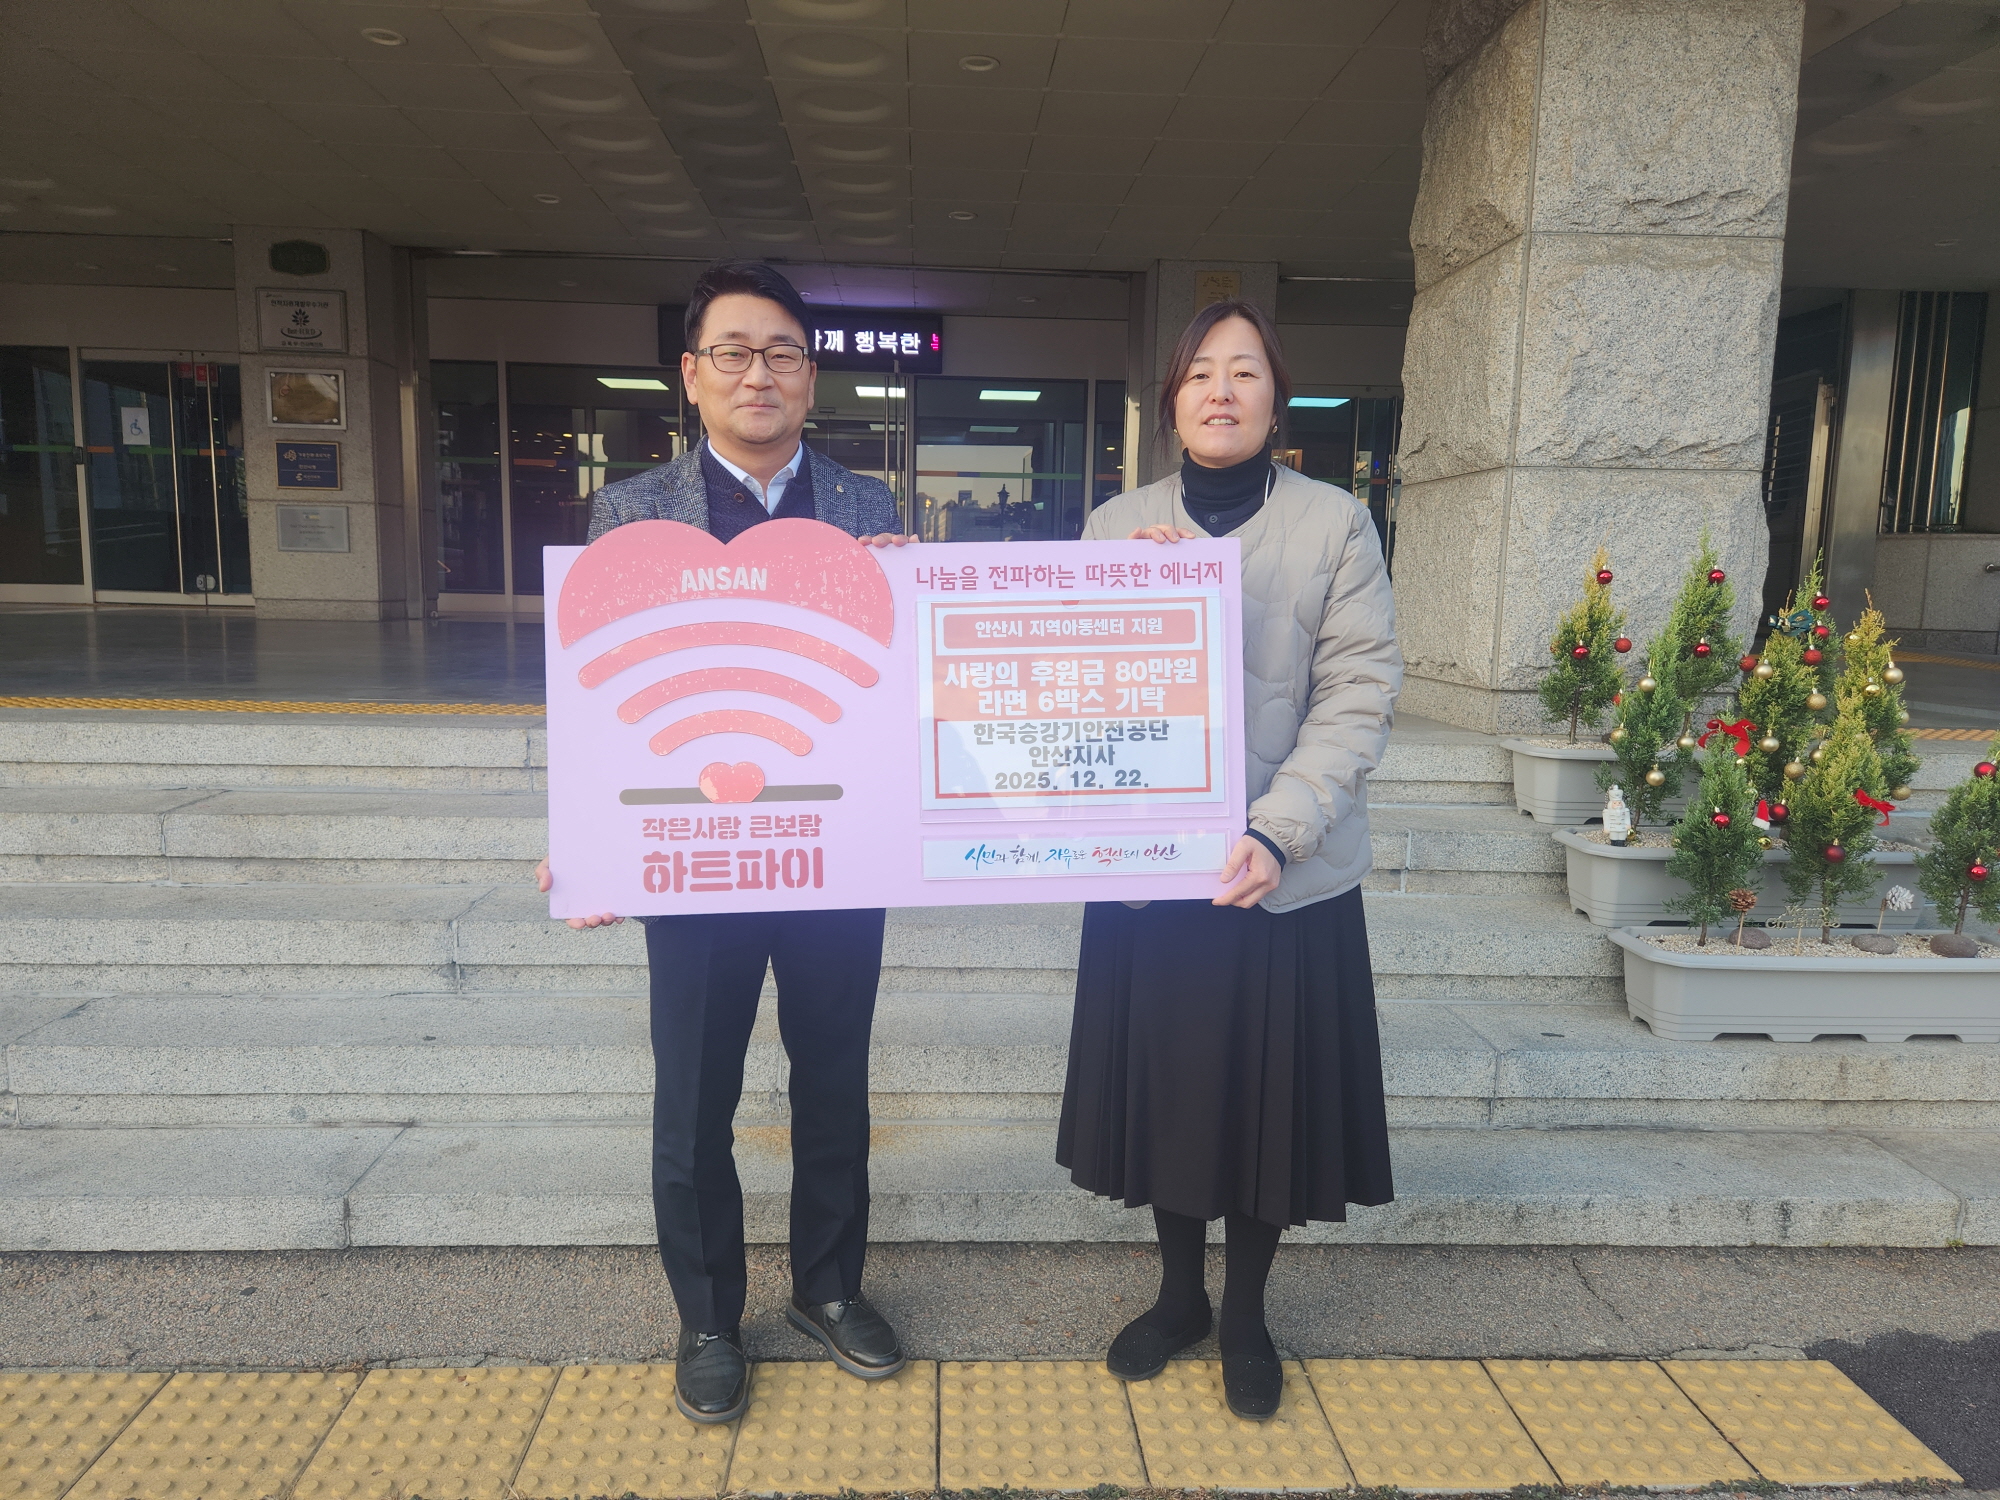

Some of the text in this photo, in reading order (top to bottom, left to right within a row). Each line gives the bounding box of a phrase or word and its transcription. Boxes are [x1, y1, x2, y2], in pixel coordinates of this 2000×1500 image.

[855, 331, 921, 355] 행복한
[681, 566, 768, 593] ANSAN
[916, 561, 1223, 591] 나눔을 전파하는 따뜻한 에너지
[975, 617, 1163, 638] 안산시 지역아동센터 지원
[943, 657, 1198, 689] 사랑의 후원금 80만원
[978, 686, 1166, 716] 라면 6박스 기탁
[973, 719, 1170, 745] 한국승강기안전공단
[1028, 744, 1116, 768] 안산지사
[994, 769, 1149, 791] 2025. 12. 22.
[641, 814, 823, 841] 작은사랑 큰보람
[642, 846, 824, 894] 하트파이
[964, 843, 1009, 870] 시민과
[1044, 848, 1087, 869] 자유로운
[1091, 846, 1139, 867] 혁신도시
[1143, 843, 1182, 861] 안산
